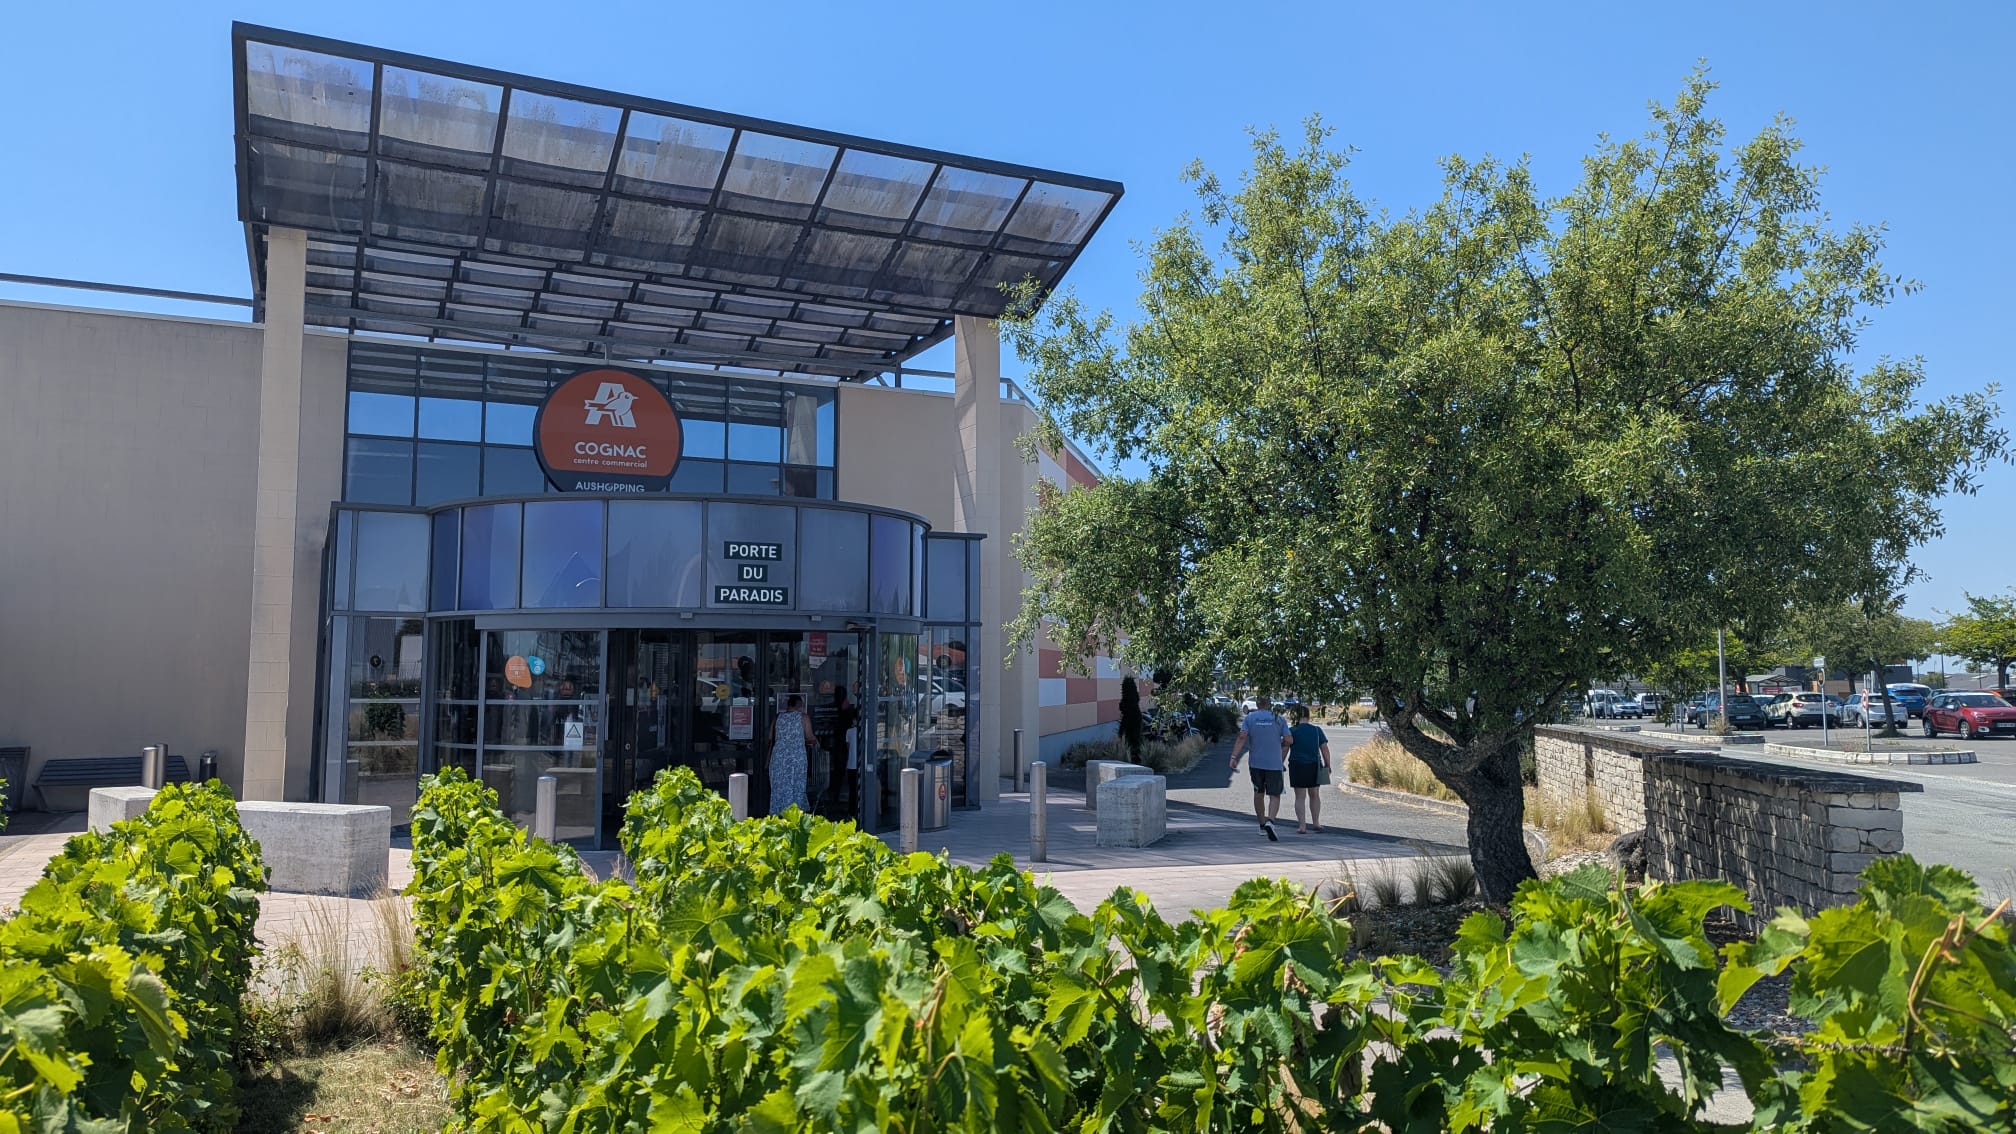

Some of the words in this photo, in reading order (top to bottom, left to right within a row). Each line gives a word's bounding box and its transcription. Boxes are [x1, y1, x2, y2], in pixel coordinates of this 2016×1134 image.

[574, 441, 647, 459] COGNAC
[573, 457, 599, 465] centre
[601, 459, 648, 468] commercial
[575, 481, 645, 493] AUSHOPPING
[729, 544, 777, 558] PORTE
[743, 566, 763, 579] DU
[720, 588, 783, 602] PARADIS
